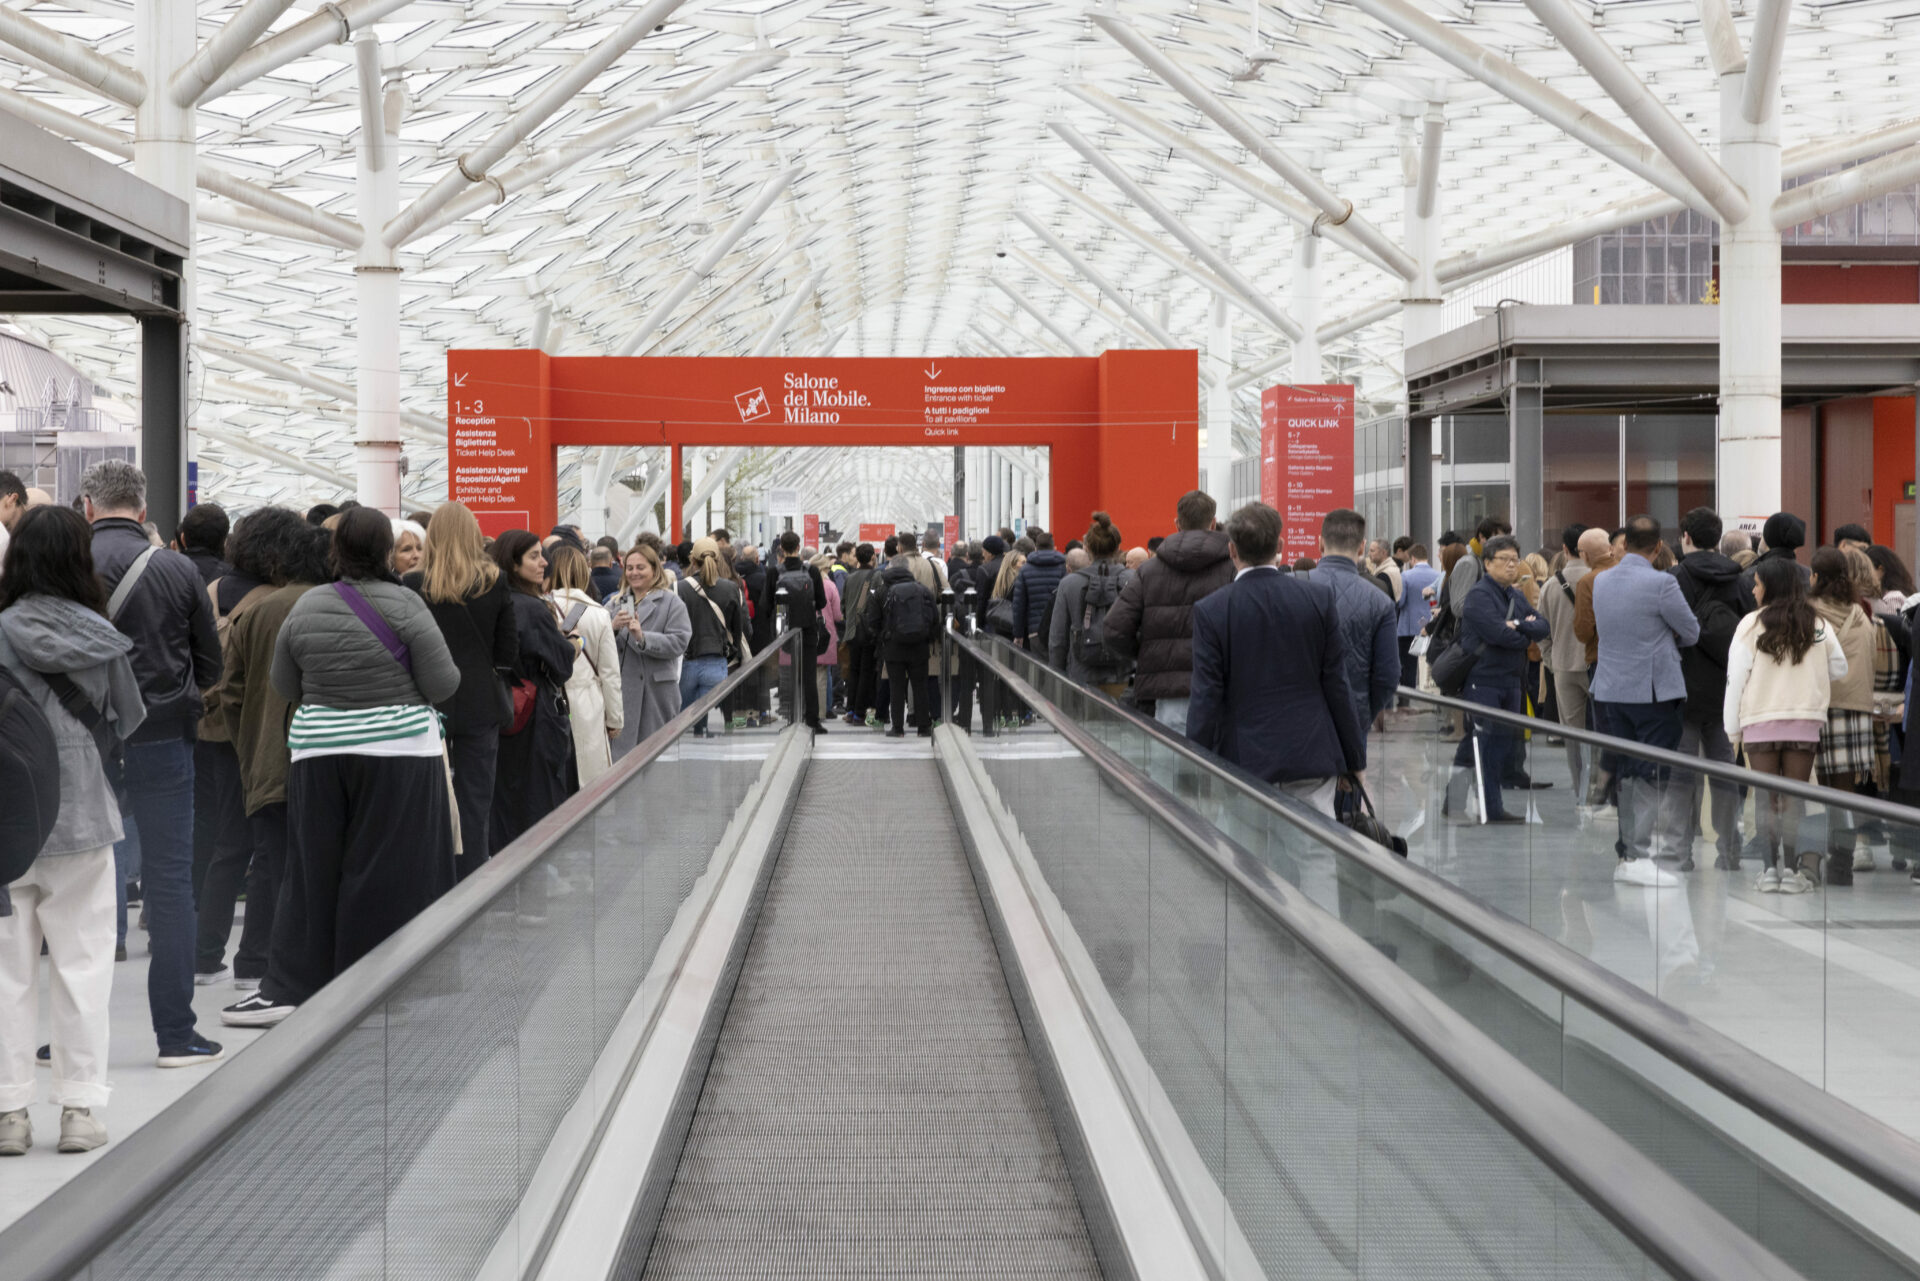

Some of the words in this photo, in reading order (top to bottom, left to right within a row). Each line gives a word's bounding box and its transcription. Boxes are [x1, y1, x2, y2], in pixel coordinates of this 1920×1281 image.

[783, 372, 839, 389] Salone
[924, 385, 957, 394] Ingresso
[974, 385, 1006, 395] biglietto
[783, 390, 808, 407] del
[813, 390, 872, 407] Mobile.
[924, 394, 957, 402] Entrance
[958, 394, 973, 402] with
[974, 394, 994, 402] ticket
[783, 407, 840, 424] Milano
[924, 406, 931, 415] A
[932, 406, 947, 415] tutti
[952, 406, 990, 416] padiglioni
[455, 417, 496, 426] Reception
[924, 415, 934, 423] To
[935, 415, 943, 423] all
[944, 415, 977, 424] pavilions
[1288, 419, 1317, 429] QUICK
[1318, 419, 1339, 429] LINK
[455, 429, 497, 437] Assistenza
[924, 427, 945, 436] Quick
[946, 427, 959, 436] link
[455, 438, 497, 447] Biglietteria
[455, 448, 477, 457] Ticket
[478, 448, 496, 458] Help
[497, 448, 516, 457] Desk
[455, 466, 497, 474] Assistenza
[498, 466, 528, 475] Ingressi
[455, 475, 521, 485] Espositori/Agenti
[455, 486, 487, 494] Exhibitor
[487, 486, 502, 494] and
[455, 495, 477, 504] Agent
[478, 495, 496, 504] Help
[497, 495, 516, 503] Desk
[1738, 523, 1757, 531] AREA
